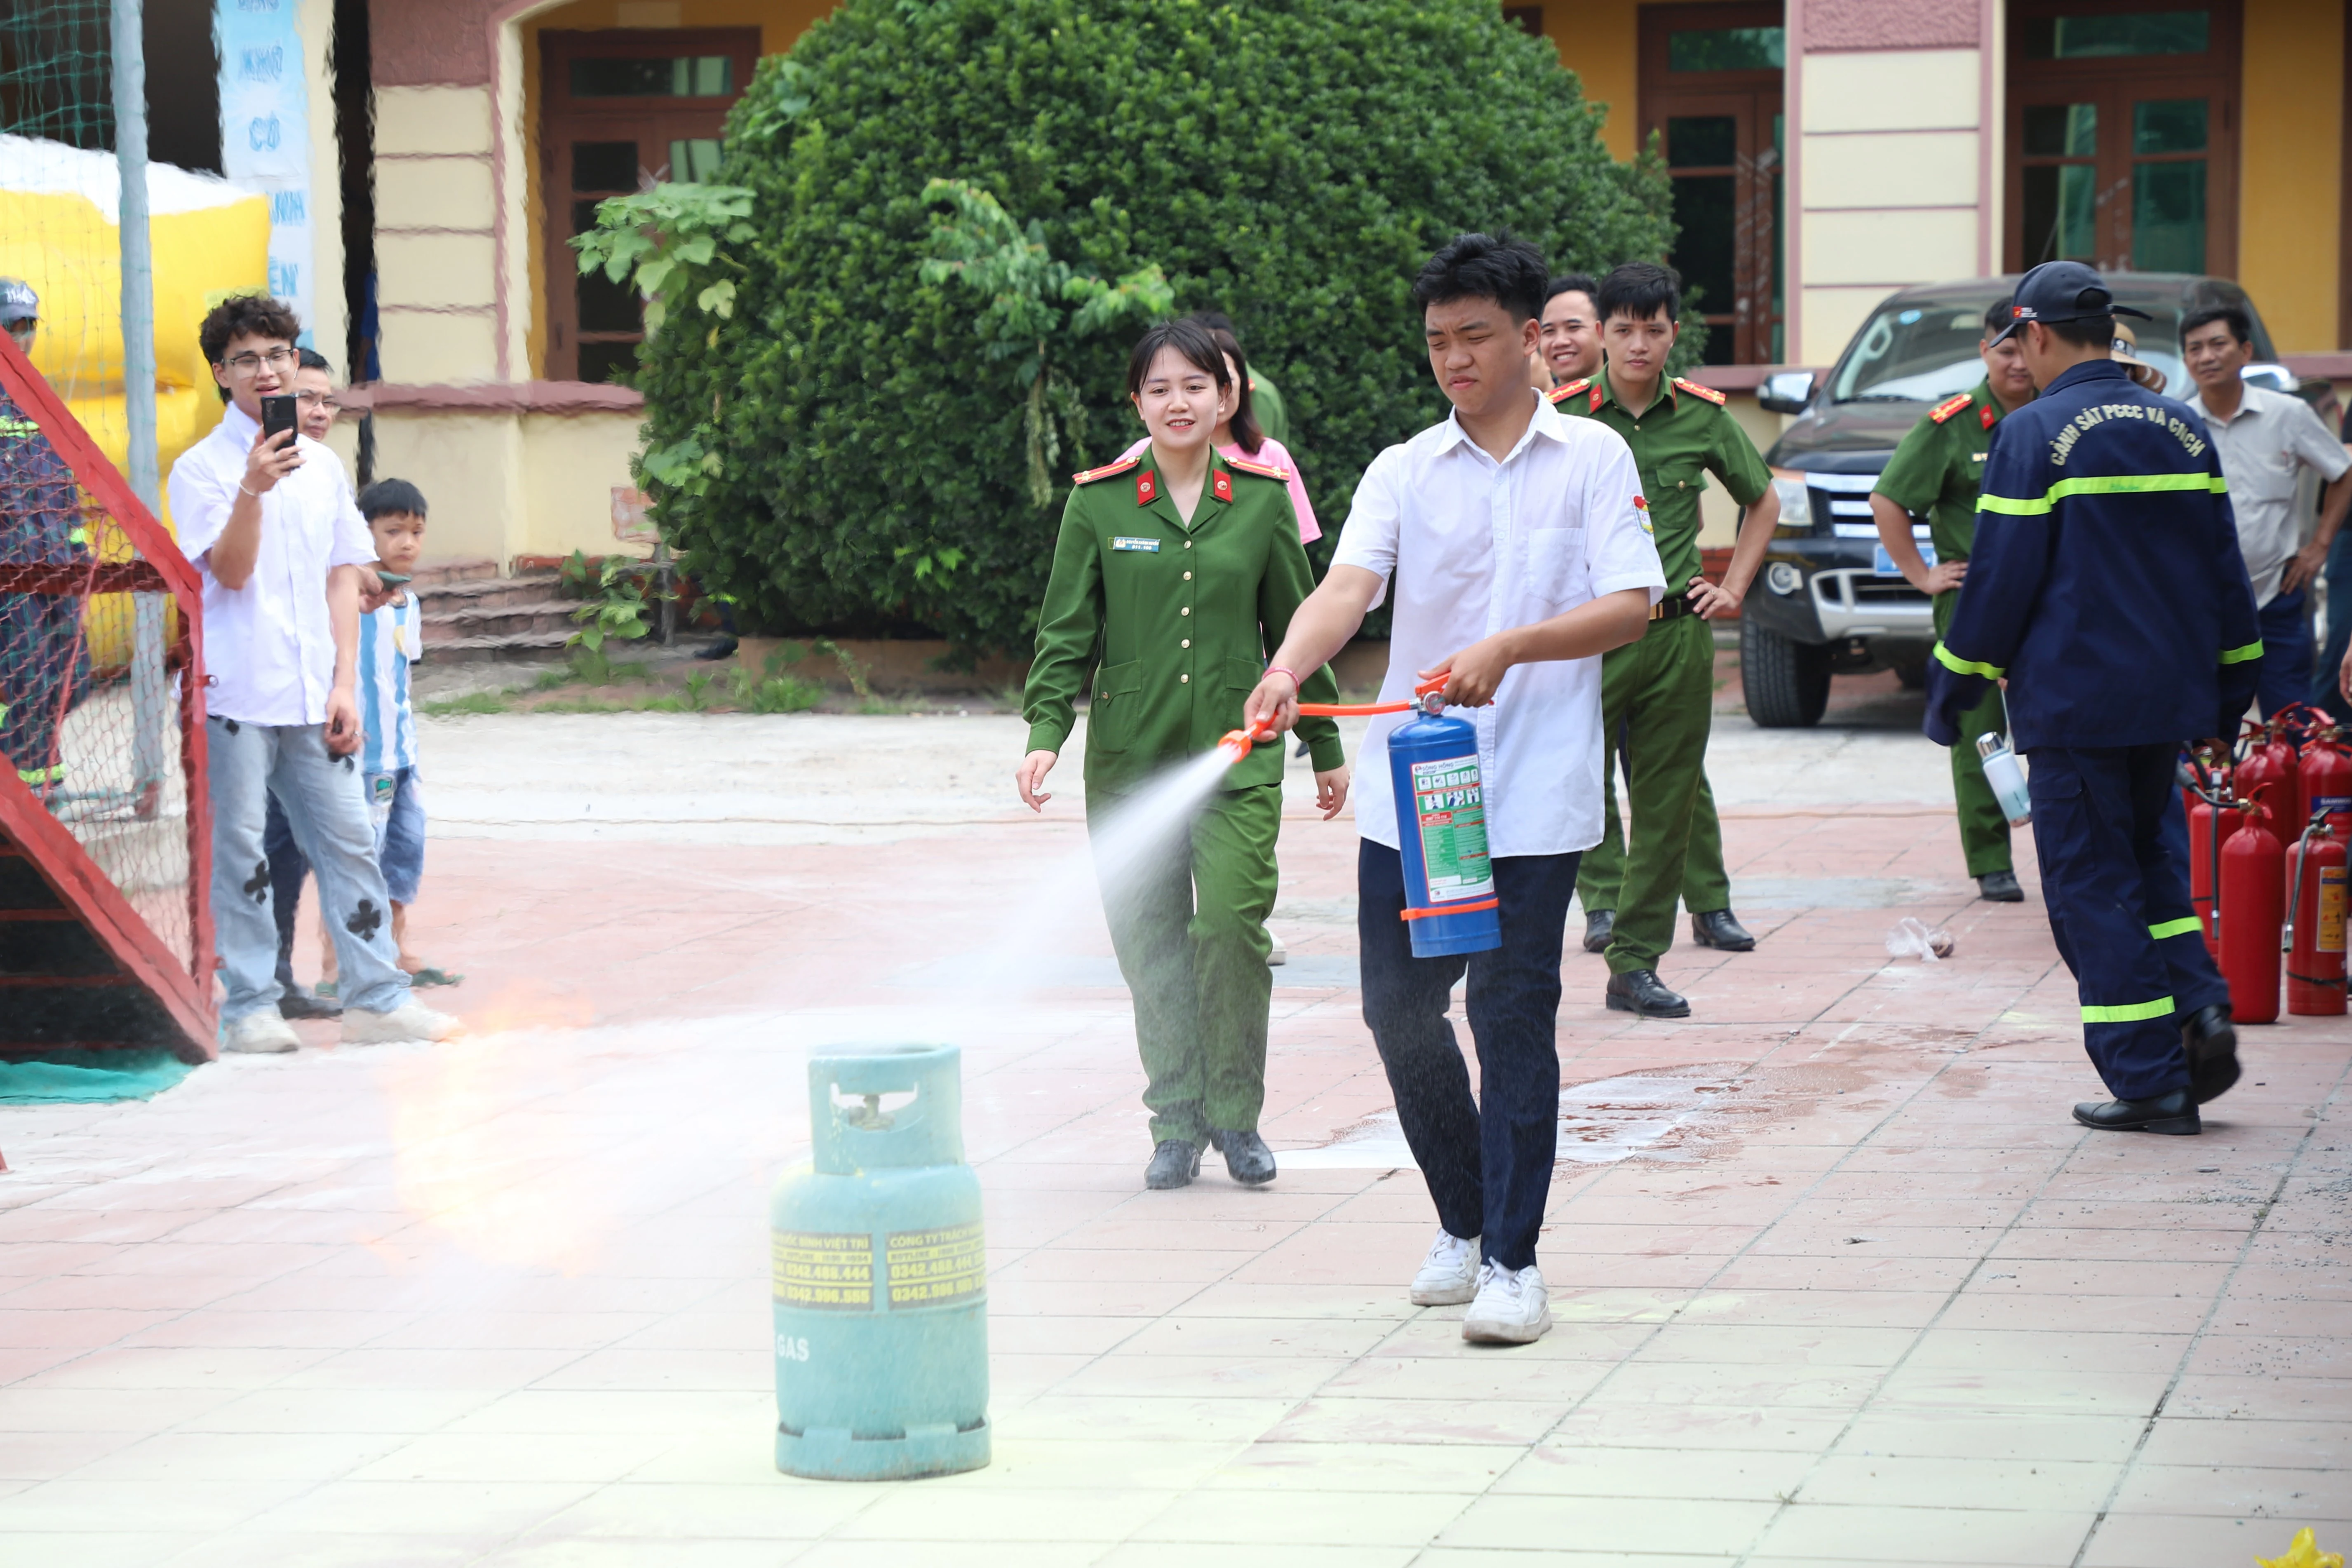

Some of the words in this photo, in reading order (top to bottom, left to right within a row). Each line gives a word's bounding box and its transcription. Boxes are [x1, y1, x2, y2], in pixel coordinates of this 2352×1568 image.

[2049, 423, 2082, 466] CẢNH
[2074, 408, 2104, 431] SÁT
[2101, 404, 2143, 420] PCCC
[2145, 406, 2166, 426] VÀ
[2168, 417, 2206, 458] CNCH
[890, 1236, 923, 1248] CÔNG
[924, 1233, 938, 1244] TY
